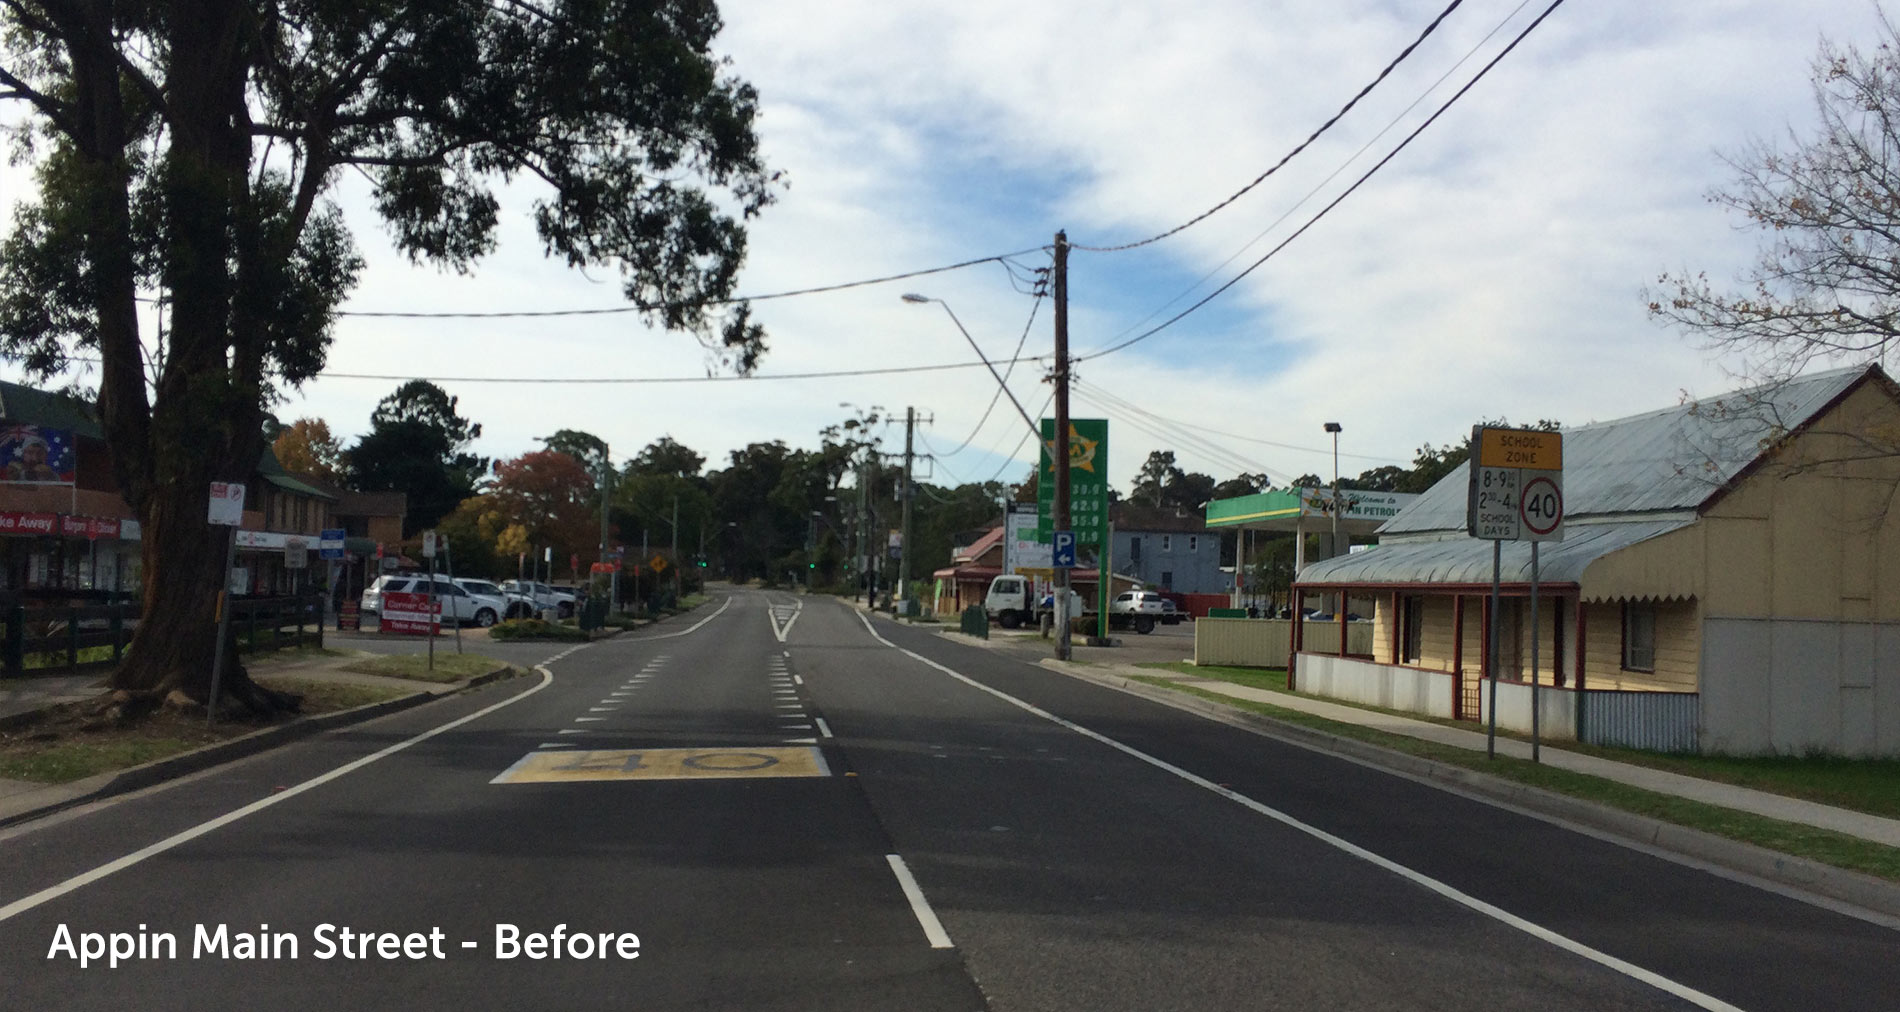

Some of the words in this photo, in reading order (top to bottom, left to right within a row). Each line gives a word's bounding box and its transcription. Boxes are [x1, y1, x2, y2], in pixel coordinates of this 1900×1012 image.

[1500, 435, 1544, 448] SCHOOL
[1506, 451, 1536, 463] ZONE
[1348, 493, 1385, 504] Welcome
[1528, 493, 1556, 518] 40
[18, 516, 52, 532] Away
[1480, 513, 1515, 524] SCHOOL
[1484, 526, 1510, 535] DAYS
[1056, 535, 1072, 552] P
[551, 752, 780, 773] 40
